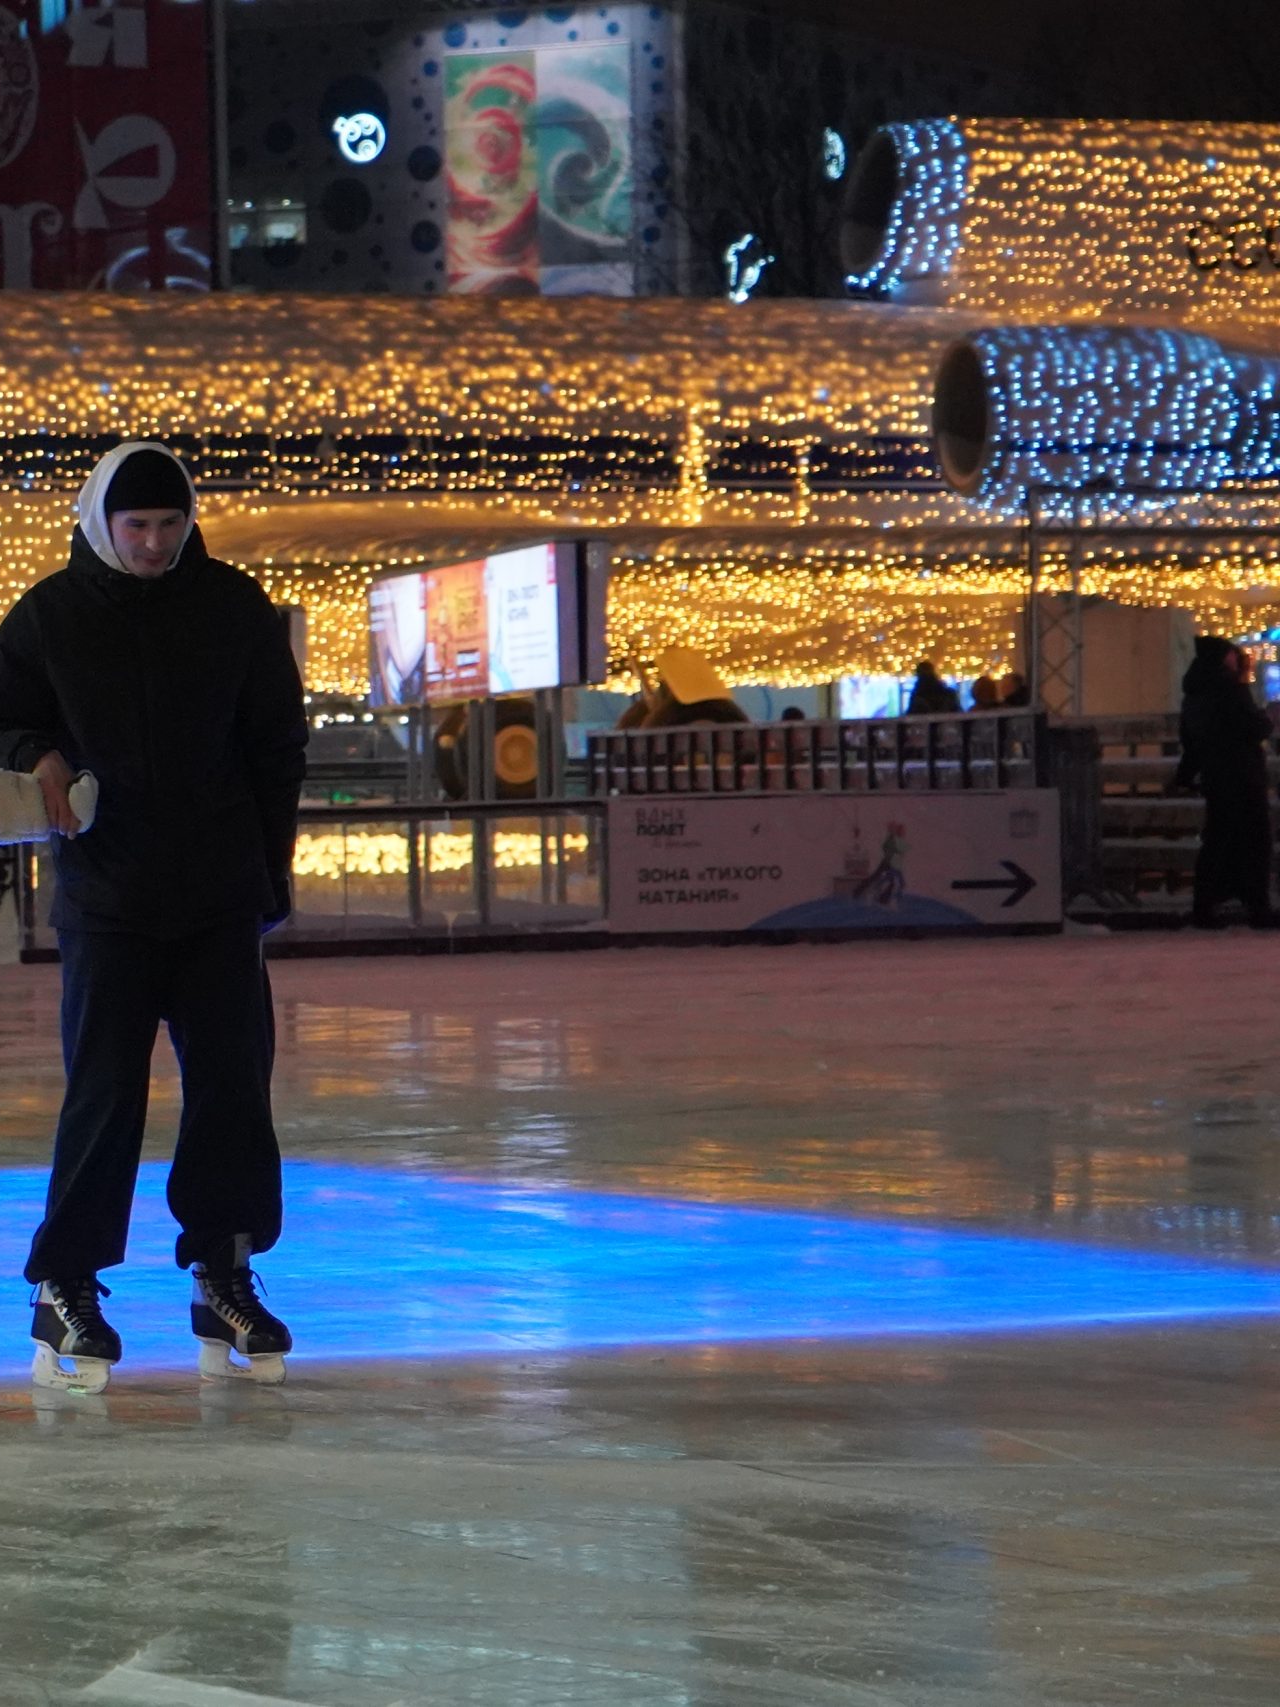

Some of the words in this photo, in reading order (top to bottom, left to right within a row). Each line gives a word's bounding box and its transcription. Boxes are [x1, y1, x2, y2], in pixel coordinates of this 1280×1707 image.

[636, 808, 685, 823] ВДНХ
[636, 823, 686, 836] ПОЛЕТ
[637, 867, 690, 882] ЗОНА
[697, 865, 783, 881] «ТИХОГО
[638, 888, 739, 904] НАТАНИЯ»
